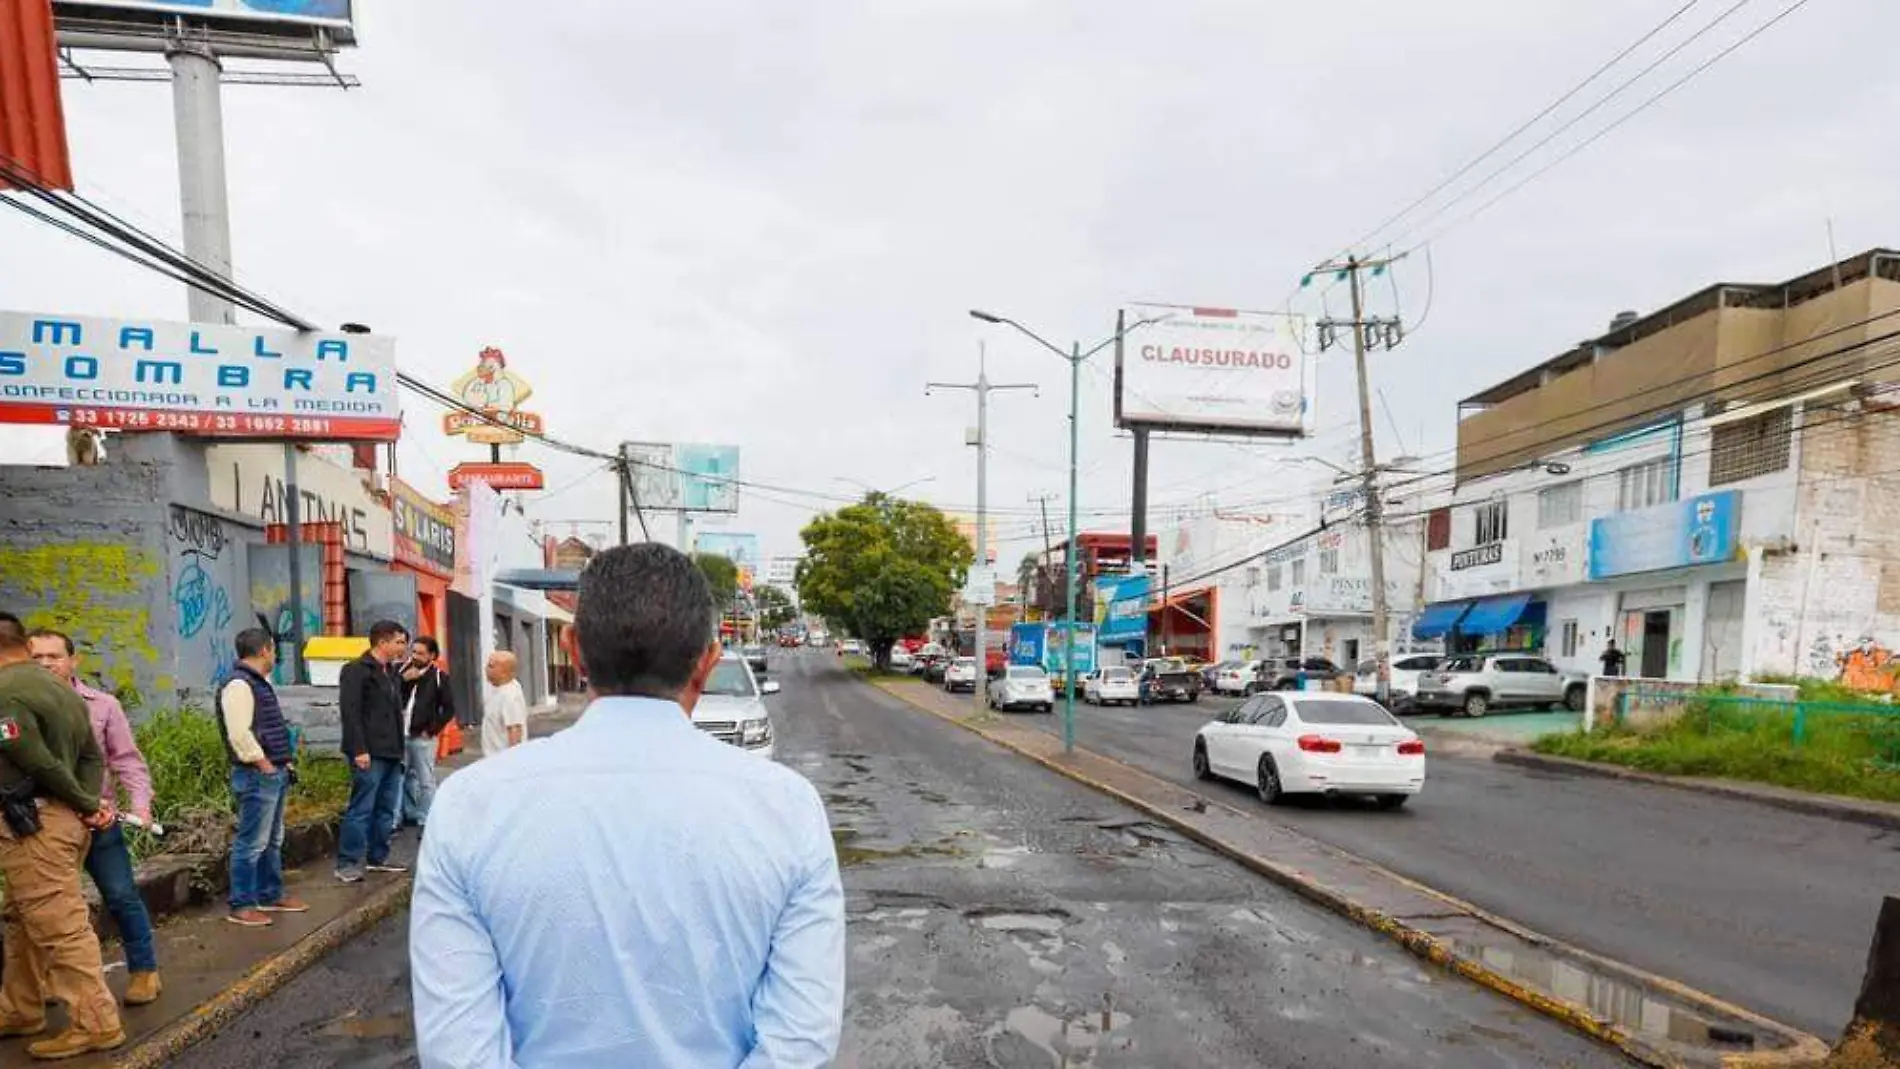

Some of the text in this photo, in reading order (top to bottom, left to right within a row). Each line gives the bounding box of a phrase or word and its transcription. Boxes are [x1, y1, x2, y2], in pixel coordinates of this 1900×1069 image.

[33, 319, 348, 361] MALLA
[1141, 345, 1291, 370] CLAUSURADO
[0, 351, 377, 393] SOMBRA
[0, 384, 382, 412] ONFECCIONADA A LA MEDIDA
[75, 409, 97, 423] 33
[216, 415, 237, 429] 33
